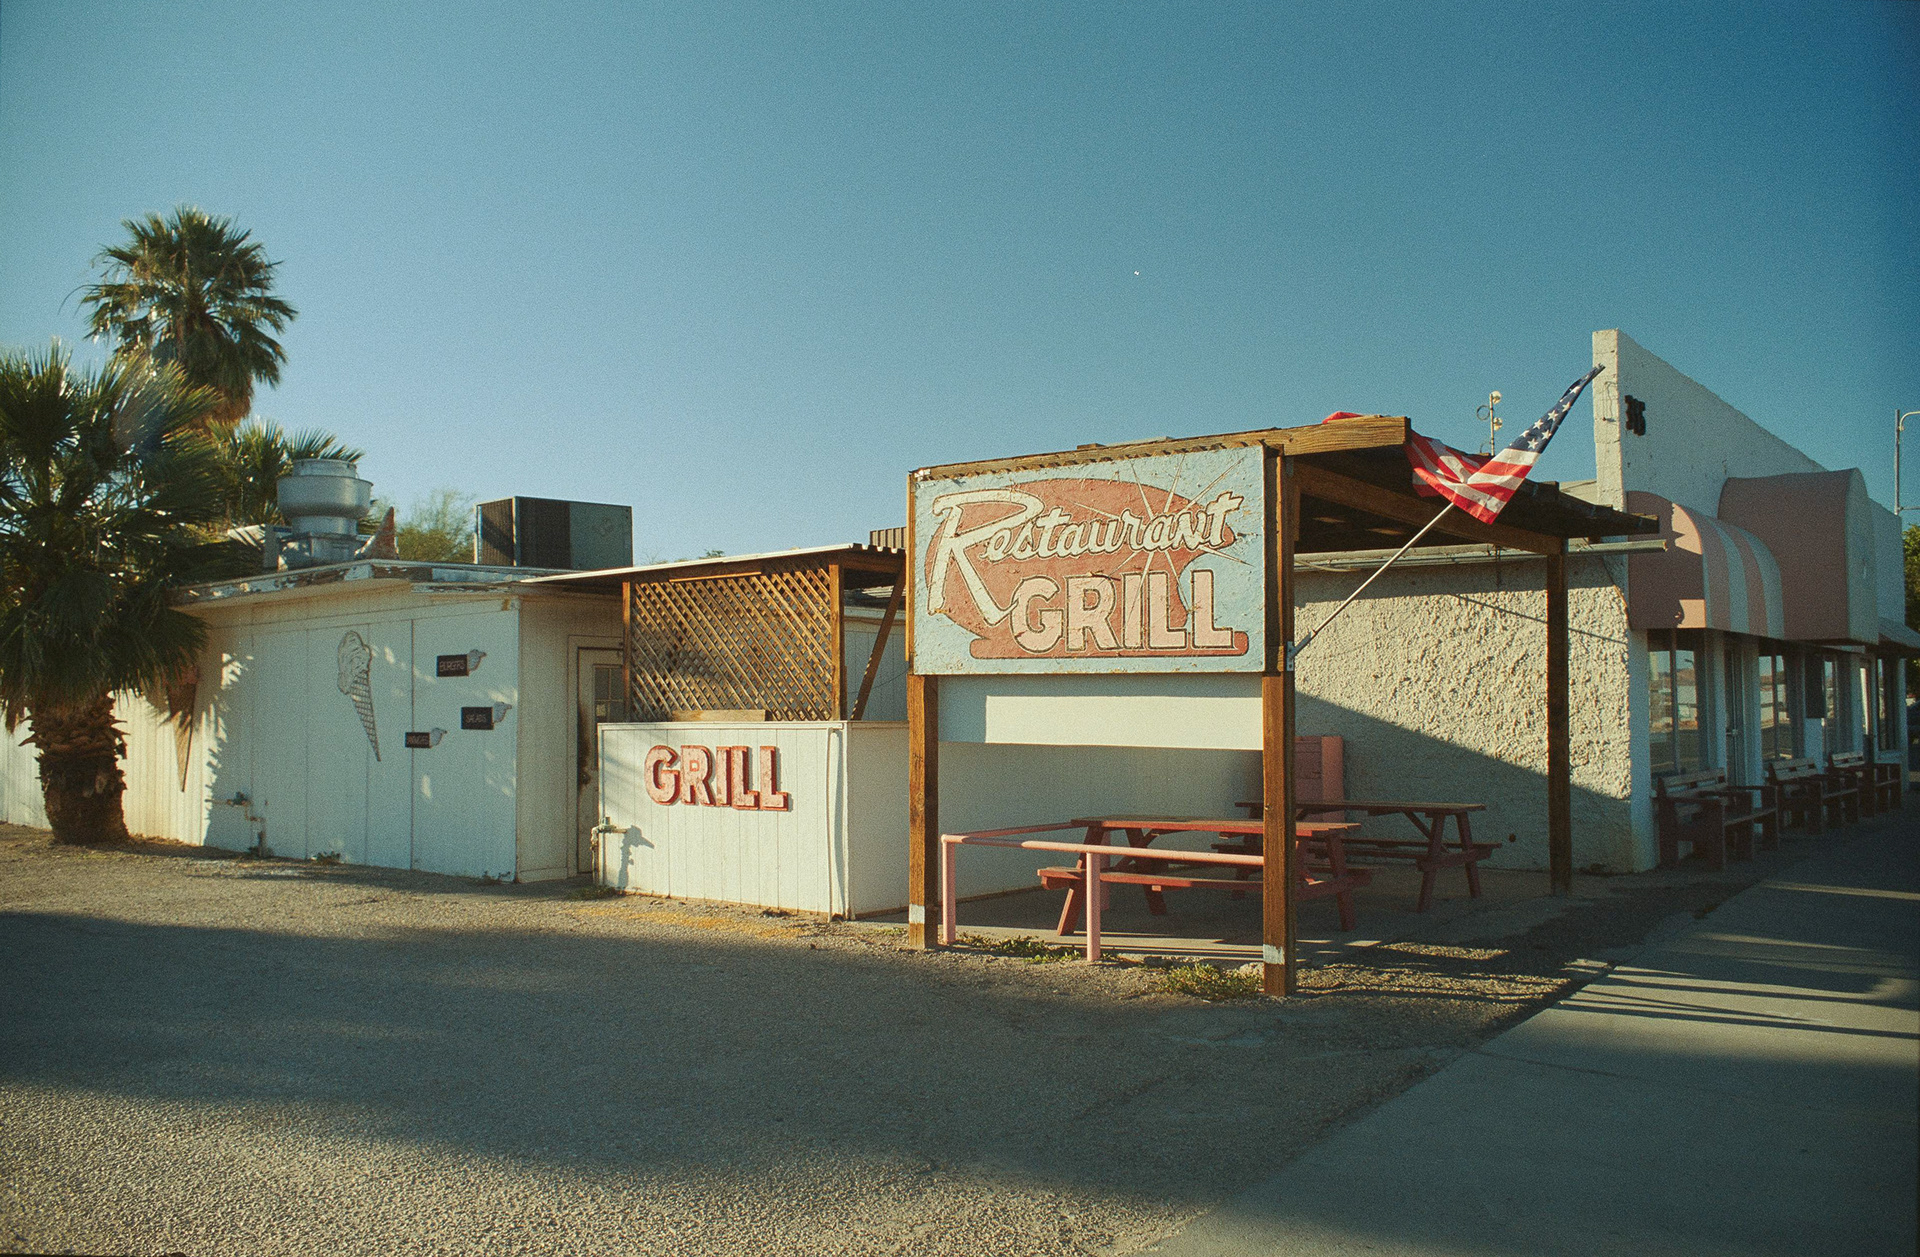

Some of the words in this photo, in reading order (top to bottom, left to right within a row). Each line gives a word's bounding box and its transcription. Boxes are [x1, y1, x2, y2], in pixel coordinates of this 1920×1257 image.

[928, 488, 1244, 627] Restaurant
[1010, 568, 1235, 654] GRILL
[439, 659, 465, 672] BURGERS
[644, 744, 789, 812] GRILL
